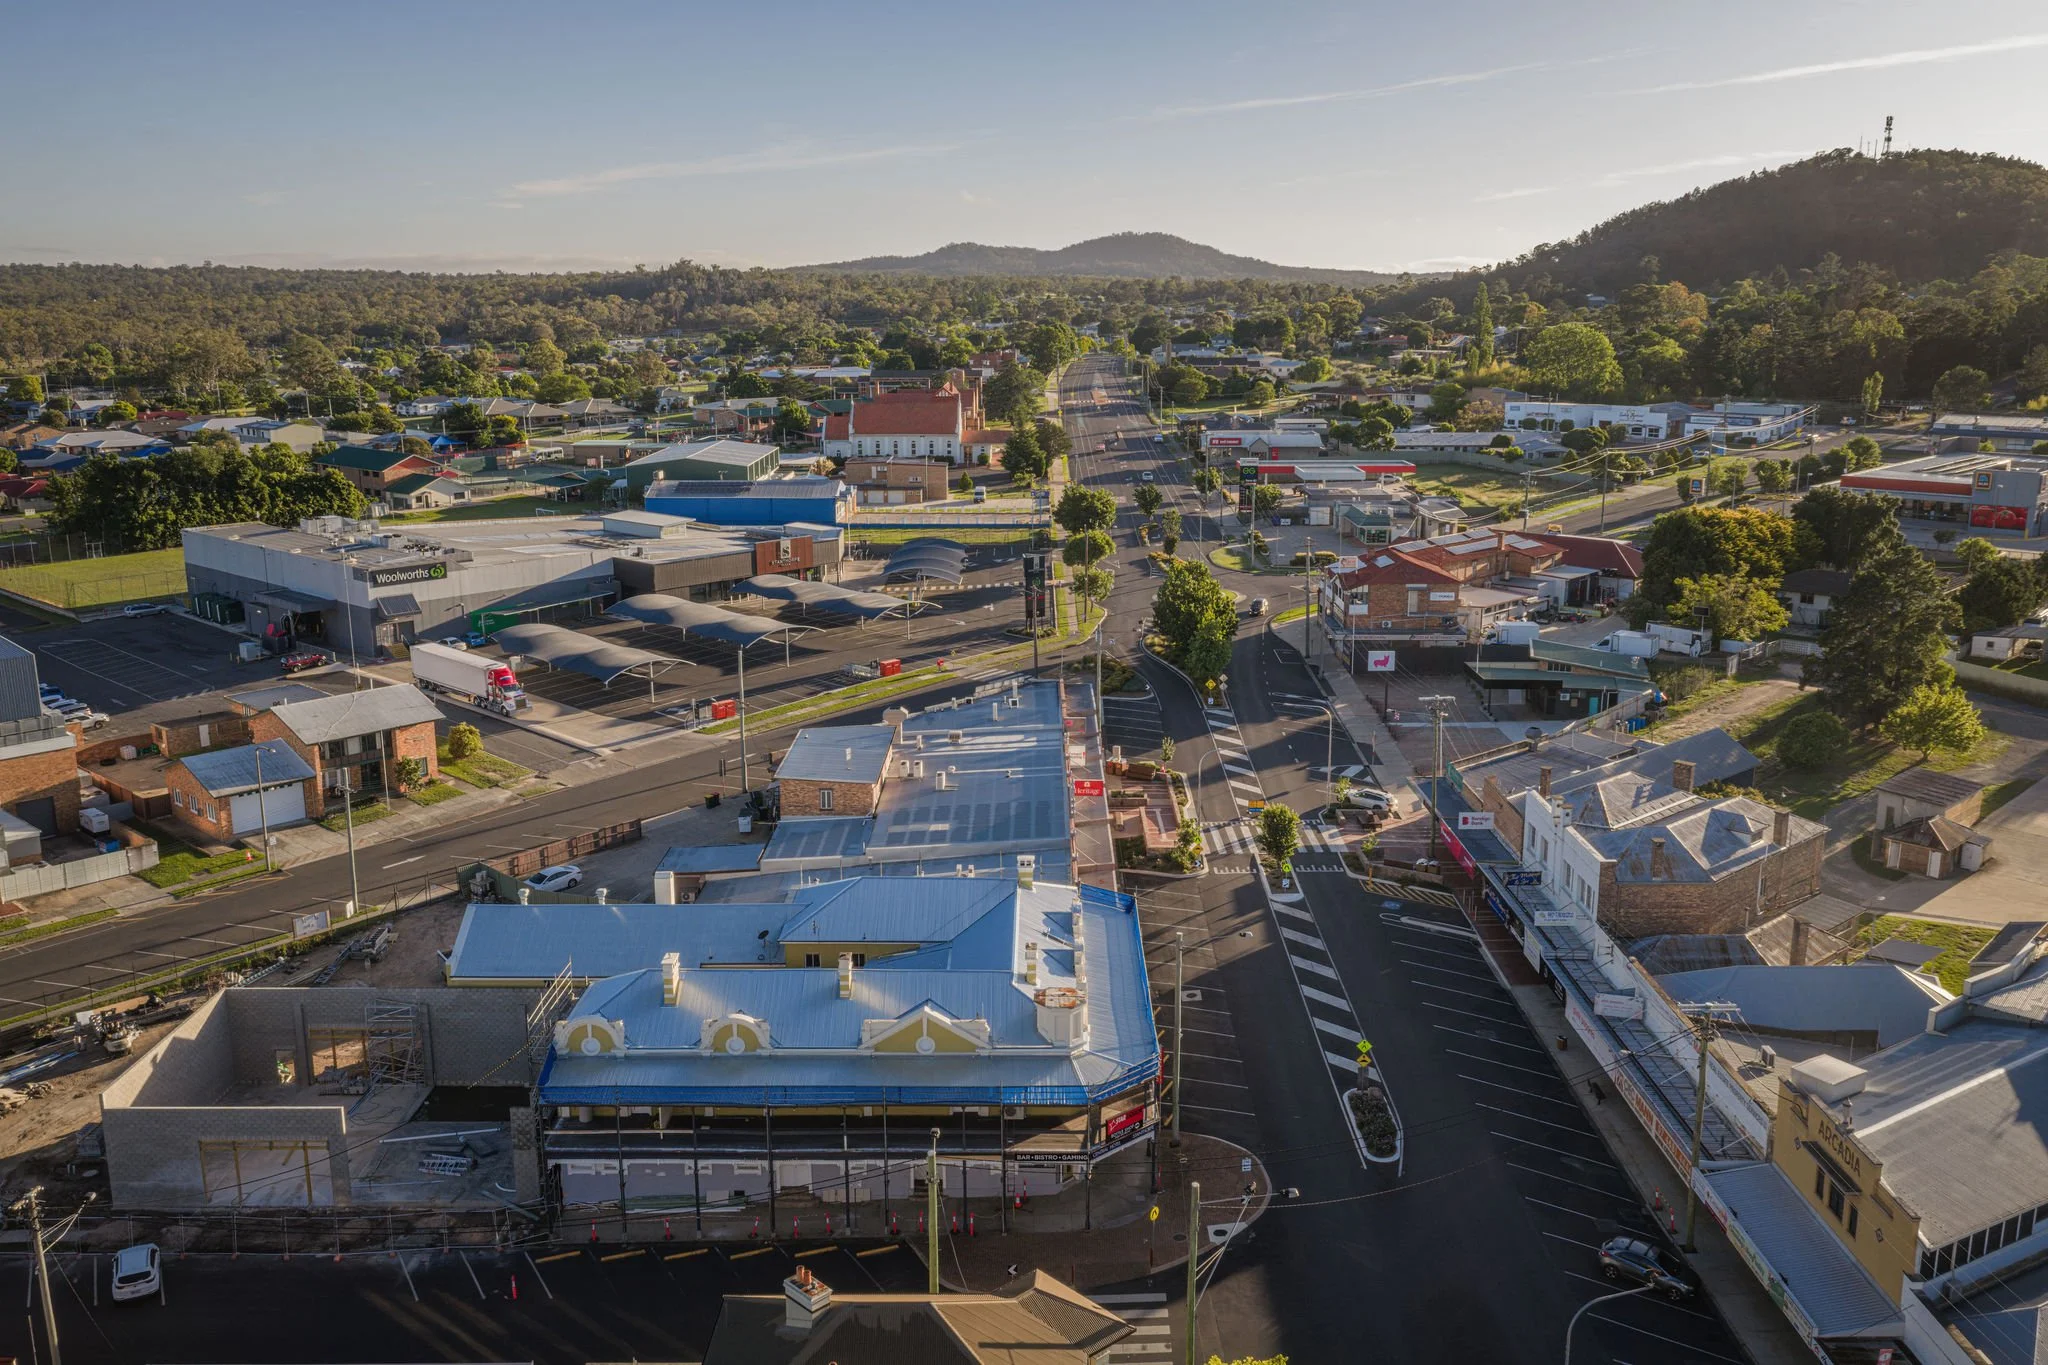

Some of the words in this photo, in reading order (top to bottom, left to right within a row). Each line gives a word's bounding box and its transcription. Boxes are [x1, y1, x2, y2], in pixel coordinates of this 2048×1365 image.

[376, 568, 429, 583] Woolworths
[1074, 787, 1100, 795] Heritage
[1819, 1120, 1861, 1177] ARCADIA
